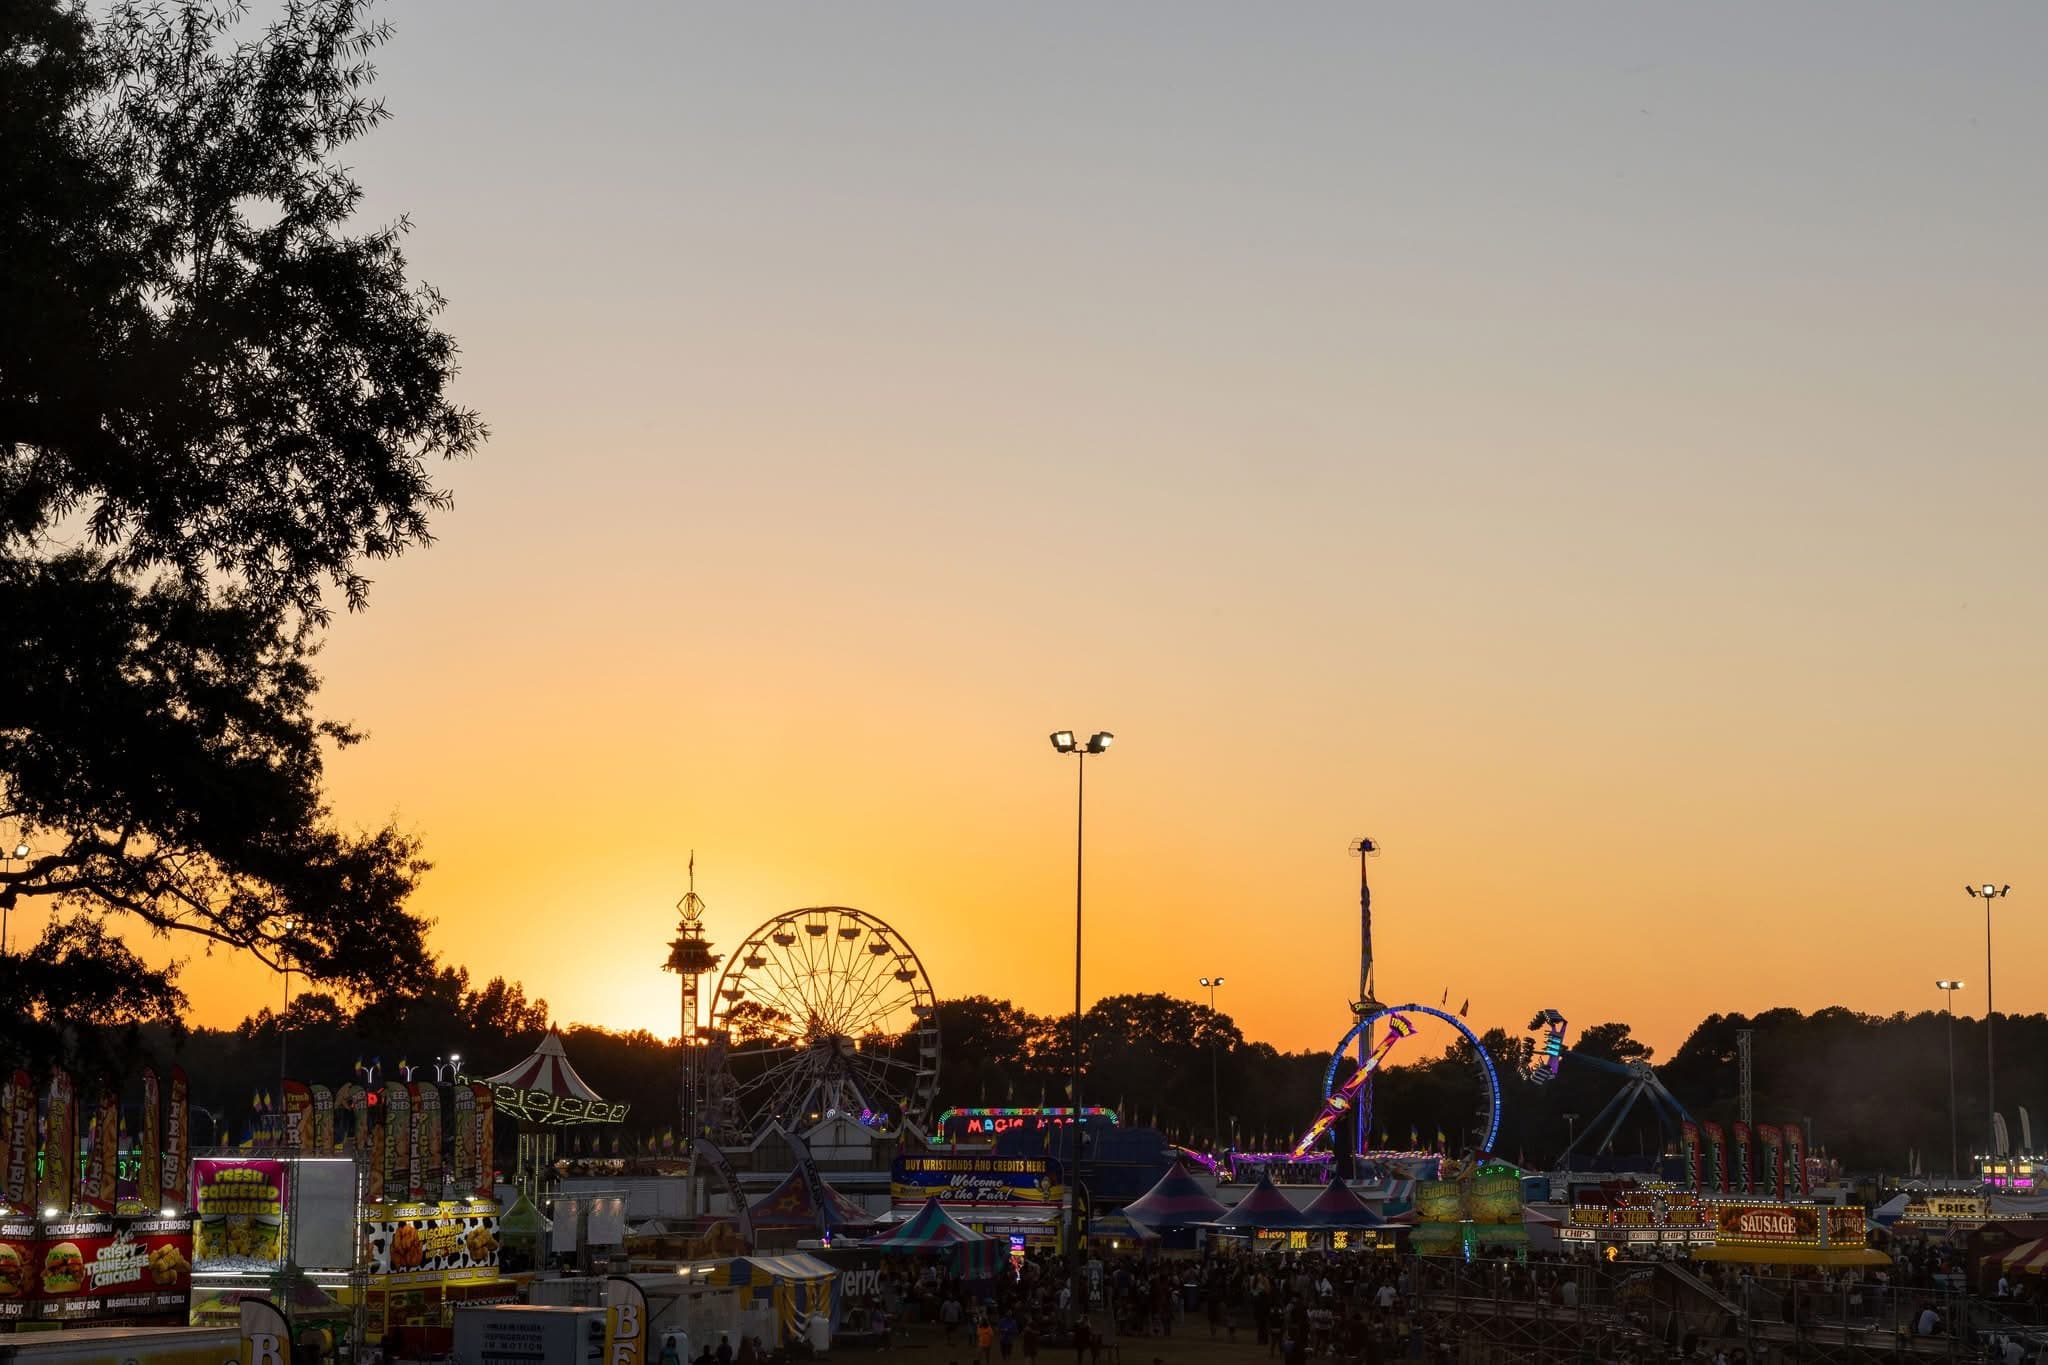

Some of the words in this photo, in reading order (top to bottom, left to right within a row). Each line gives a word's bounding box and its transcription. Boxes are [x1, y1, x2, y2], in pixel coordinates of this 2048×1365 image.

[161, 1102, 181, 1189] FRIES
[384, 1112, 398, 1180] PICKLE
[8, 1109, 28, 1202] FRIES
[904, 1160, 921, 1171] BUY
[922, 1159, 972, 1171] WRISTBANDS
[974, 1160, 991, 1171] AND
[993, 1160, 1024, 1172] CREDITS
[1026, 1160, 1047, 1173] HERE
[214, 1168, 264, 1183] FRESH
[950, 1173, 1004, 1187] Welcome
[200, 1183, 279, 1199] SQUEEZED
[940, 1189, 952, 1200] to
[953, 1188, 974, 1200] the
[976, 1187, 1013, 1201] Fair!
[199, 1200, 280, 1215] LEMONADE
[393, 1207, 418, 1217] CHEESE
[418, 1206, 441, 1216] CURDS
[1938, 1203, 1976, 1214] FRIES
[2, 1225, 35, 1235] SHRIMP
[45, 1224, 76, 1235] CHICKEN
[130, 1221, 159, 1232] CHICKEN
[160, 1220, 191, 1231] TENDERS
[418, 1223, 465, 1240] WISCONSIN
[1740, 1215, 1797, 1234] SAUSAGE
[1829, 1216, 1862, 1234] SAUSAGE
[1565, 1230, 1591, 1238] CHIPS
[1662, 1231, 1686, 1239] CHIPS
[426, 1237, 459, 1250] CHEESE
[97, 1243, 138, 1259] CRISPY
[85, 1254, 149, 1275] TENNESSEE
[95, 1269, 141, 1287] CHICKEN
[6, 1303, 24, 1314] HOT
